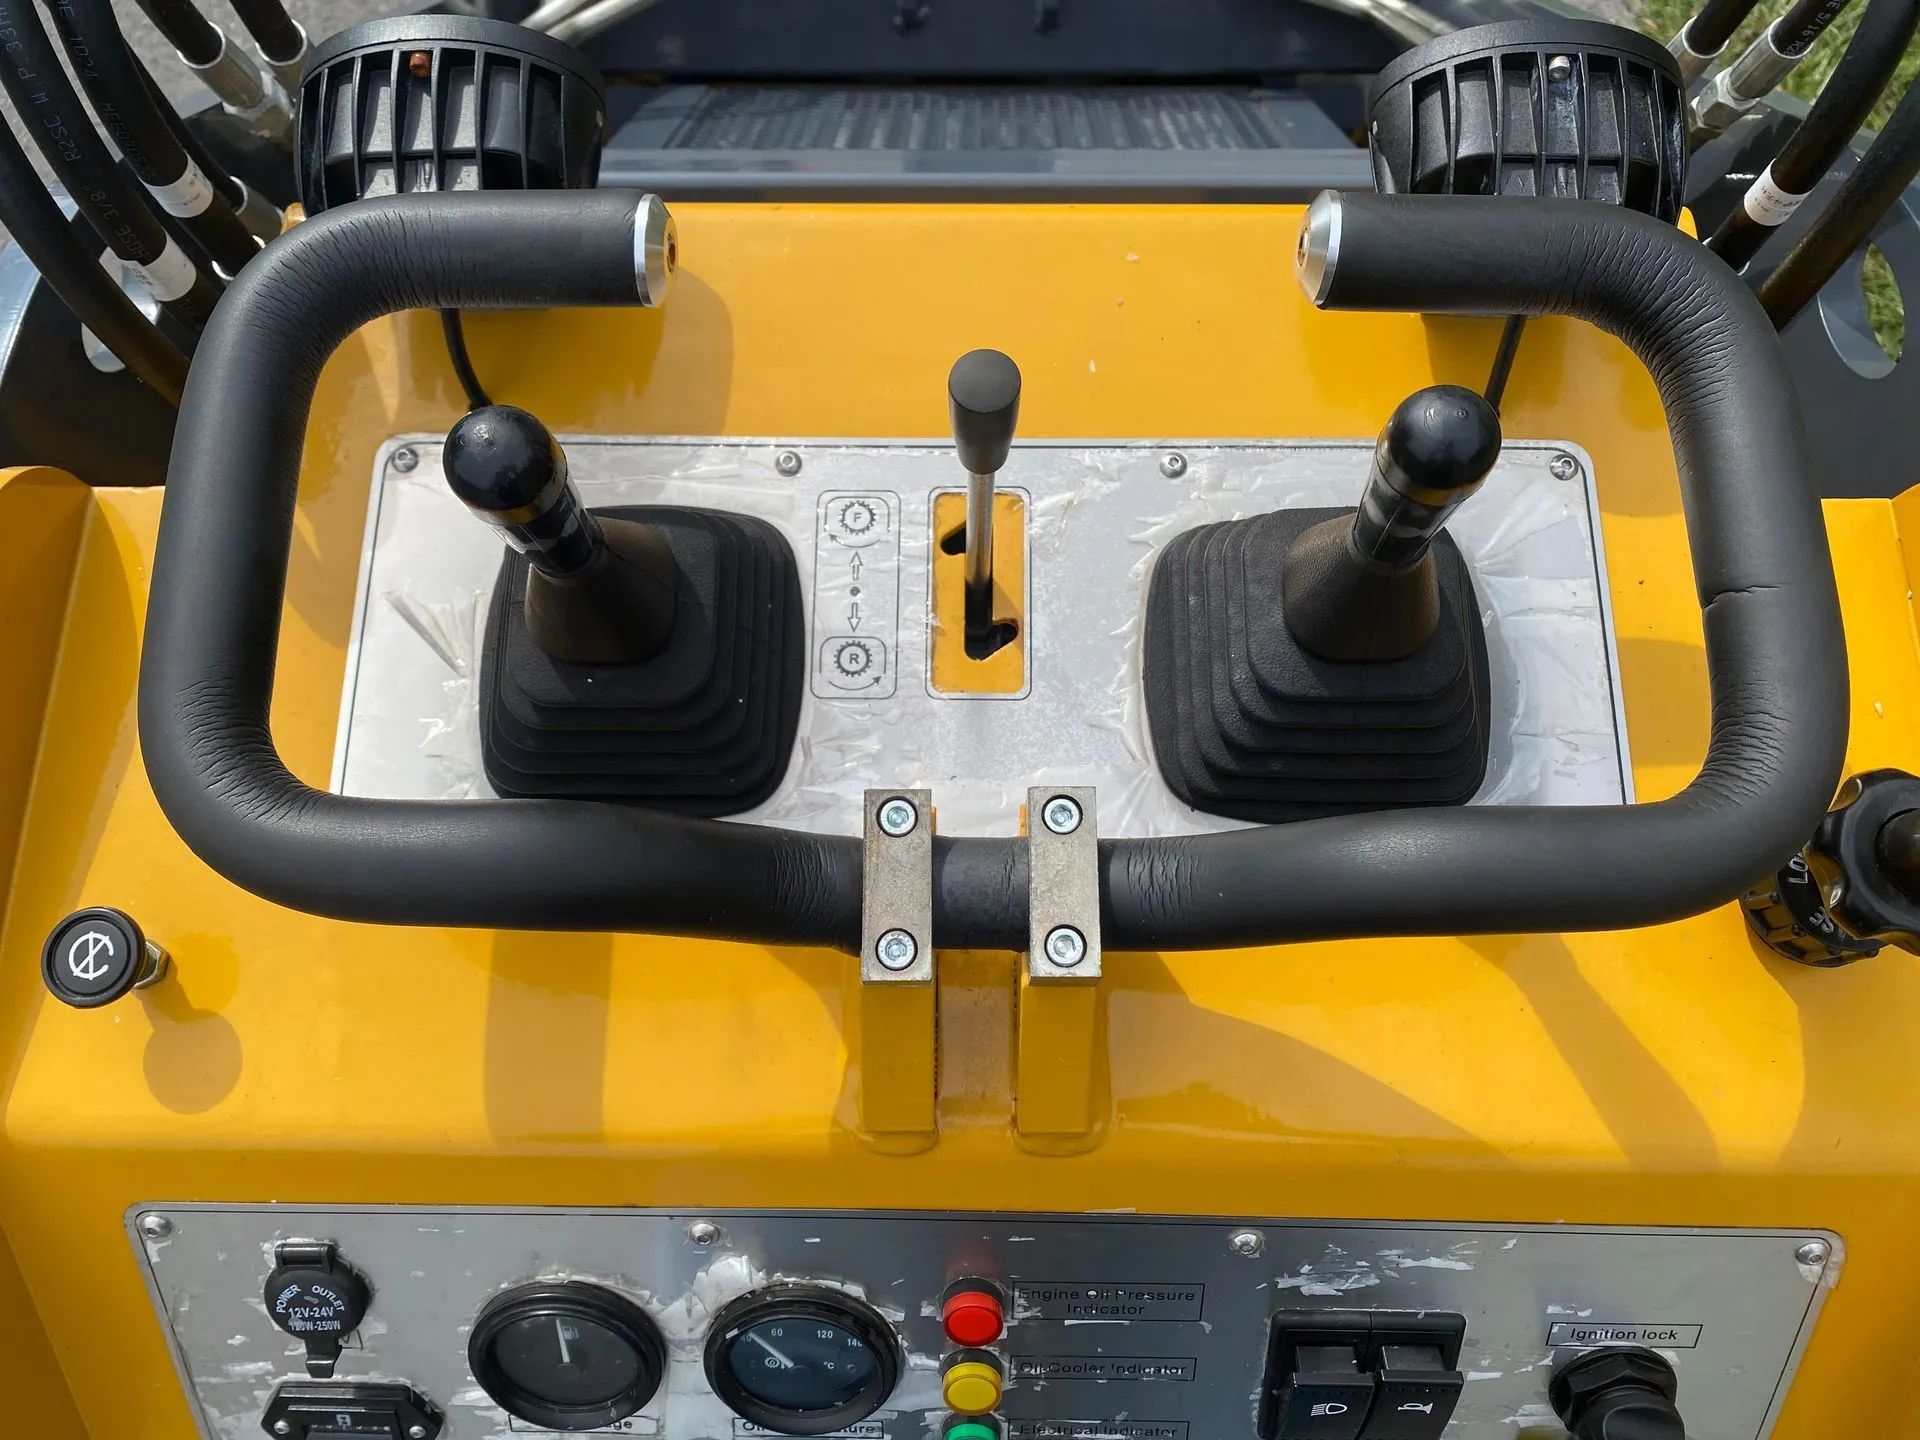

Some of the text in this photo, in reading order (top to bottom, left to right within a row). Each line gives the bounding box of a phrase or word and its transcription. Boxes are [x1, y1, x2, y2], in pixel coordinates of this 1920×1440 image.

[44, 113, 82, 163] R2SC
[853, 512, 862, 522] F
[849, 653, 860, 664] R
[276, 1284, 344, 1313] POWER OUTLET
[1018, 1288, 1196, 1302] Engine Oil Pressure
[288, 1306, 334, 1318] 12V-24V
[1067, 1303, 1145, 1315] Indicator
[816, 1330, 834, 1339] 120
[1570, 1328, 1679, 1341] Ignition lock
[1049, 1362, 1106, 1374] Cooler
[1020, 1424, 1178, 1437] Electrical Indicator
